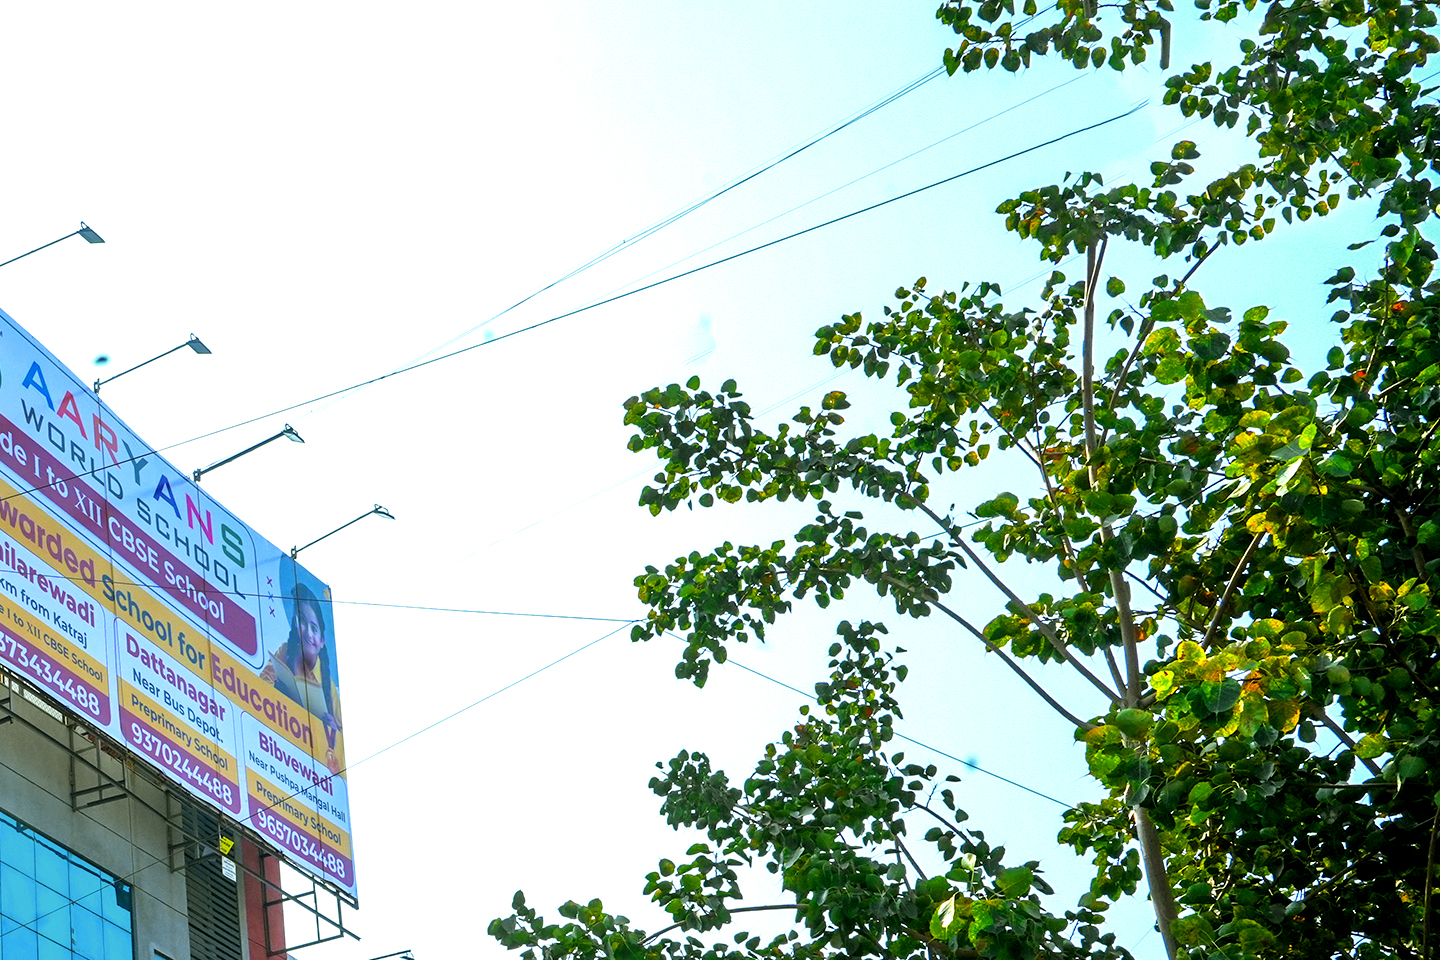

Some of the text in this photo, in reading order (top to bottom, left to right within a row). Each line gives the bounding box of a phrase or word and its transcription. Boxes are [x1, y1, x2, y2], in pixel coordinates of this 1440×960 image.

[21, 398, 246, 600] WORLD SCHOOL
[22, 360, 246, 568] AARYANS
[102, 573, 173, 648] School
[177, 632, 205, 671] for
[211, 651, 314, 749] Education
[126, 632, 226, 722] Dattanagar
[131, 694, 228, 771] Preprimary School
[131, 722, 233, 806] 9370244488
[258, 730, 334, 796] Bibvewadi
[257, 807, 345, 879] 9657034488
